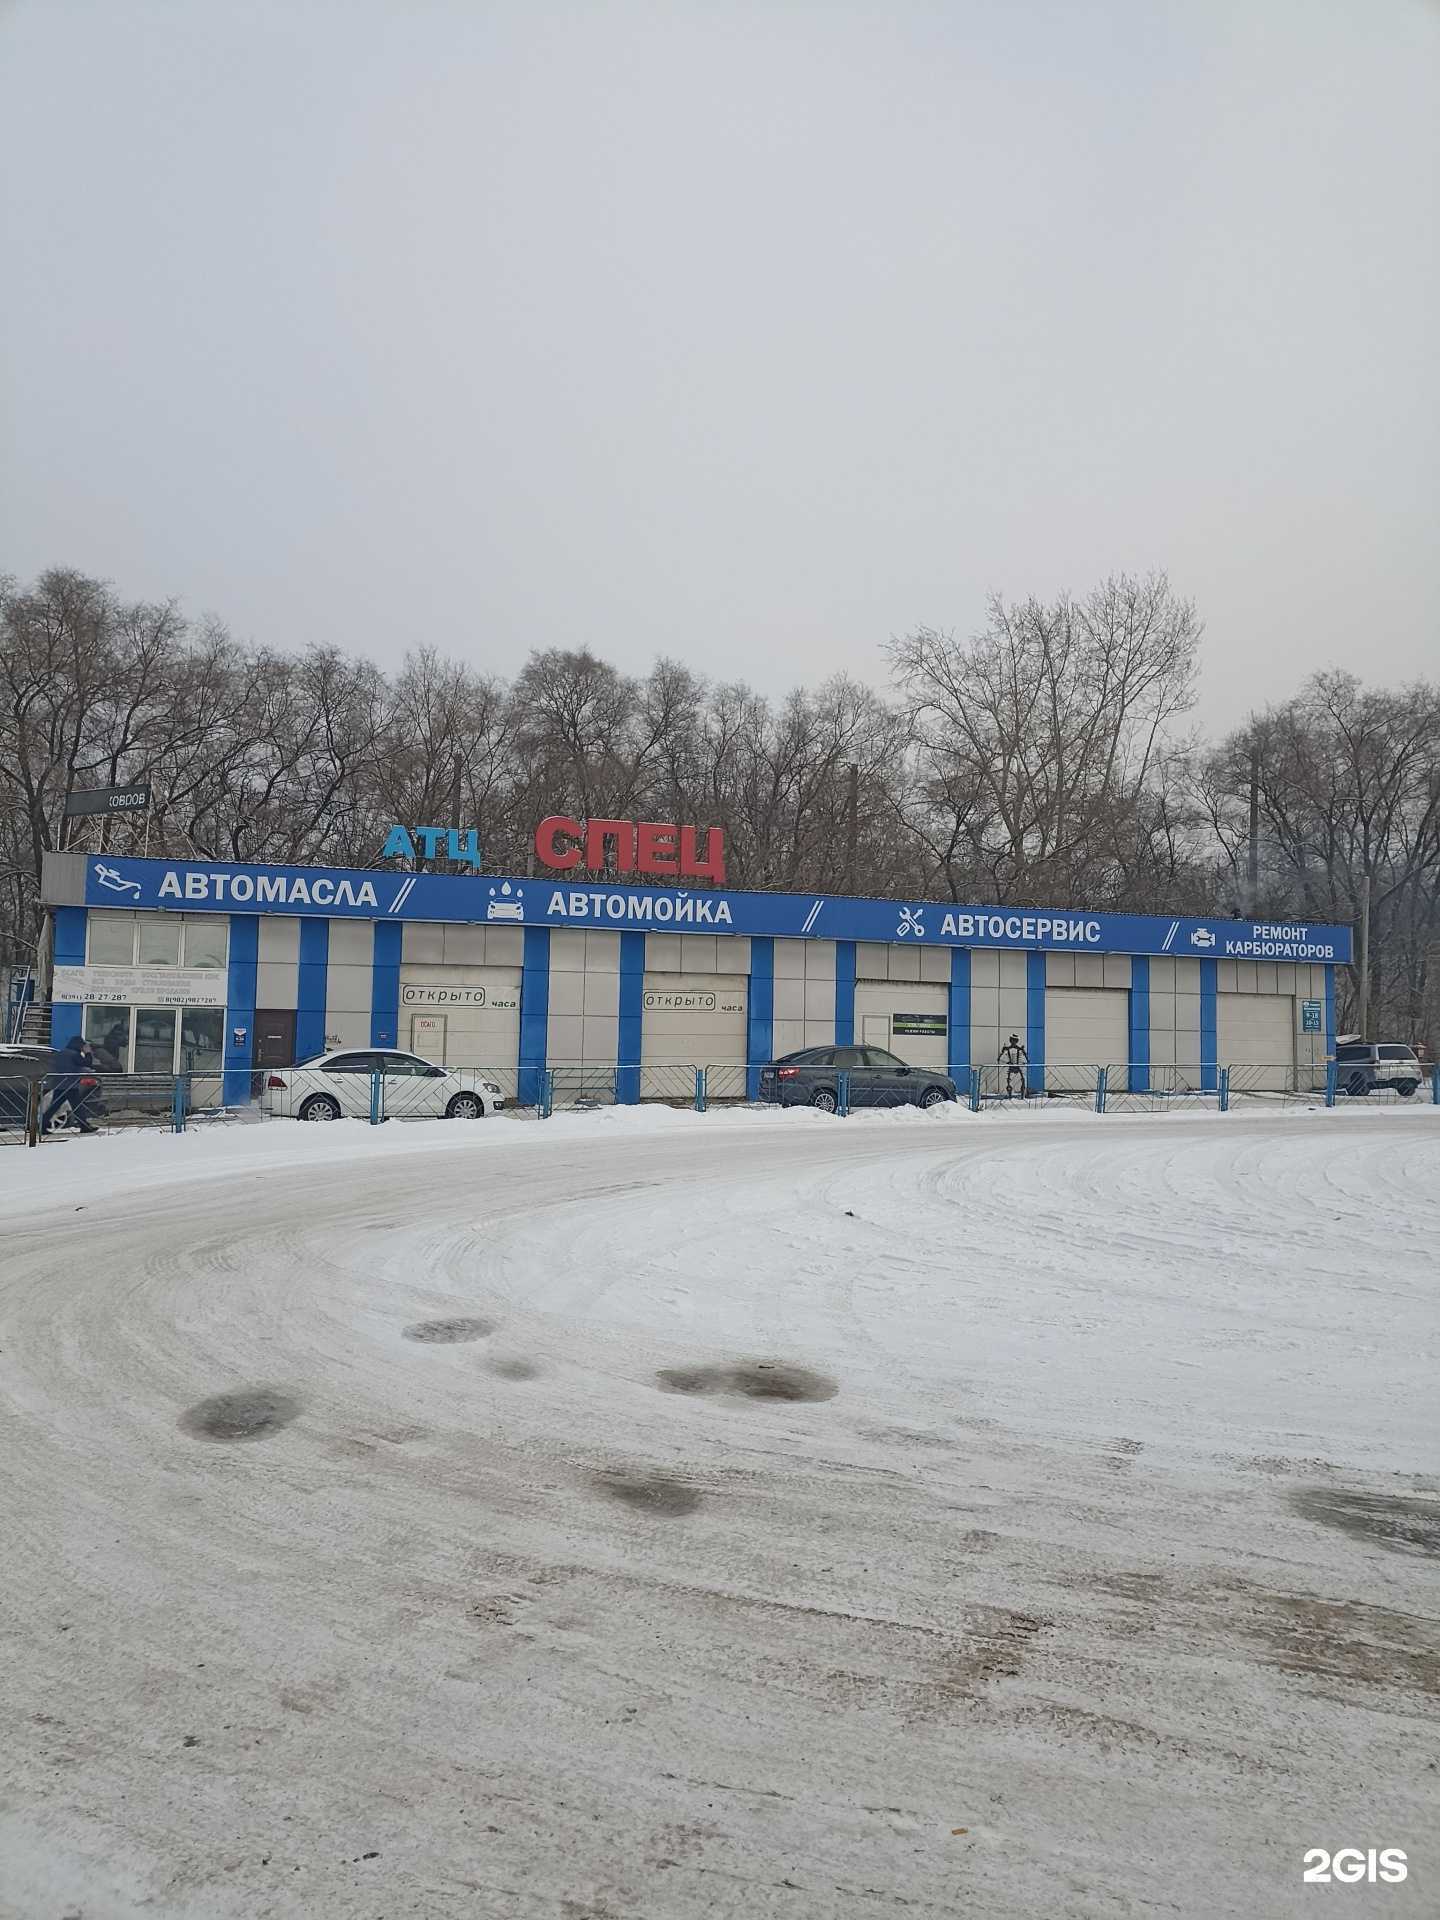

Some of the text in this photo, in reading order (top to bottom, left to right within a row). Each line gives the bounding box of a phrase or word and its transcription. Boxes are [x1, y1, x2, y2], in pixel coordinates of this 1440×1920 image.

[383, 824, 481, 869] АТЦ
[535, 815, 726, 884] СПЕЦ
[157, 871, 378, 907] АВТОМАСЛА
[546, 890, 733, 925] АВТОМОЙКА
[940, 913, 1101, 943] АВТОСЕРВИС
[1252, 925, 1308, 941] РЕМОНТ
[1225, 940, 1335, 959] КАРБЮРАТОРОВ
